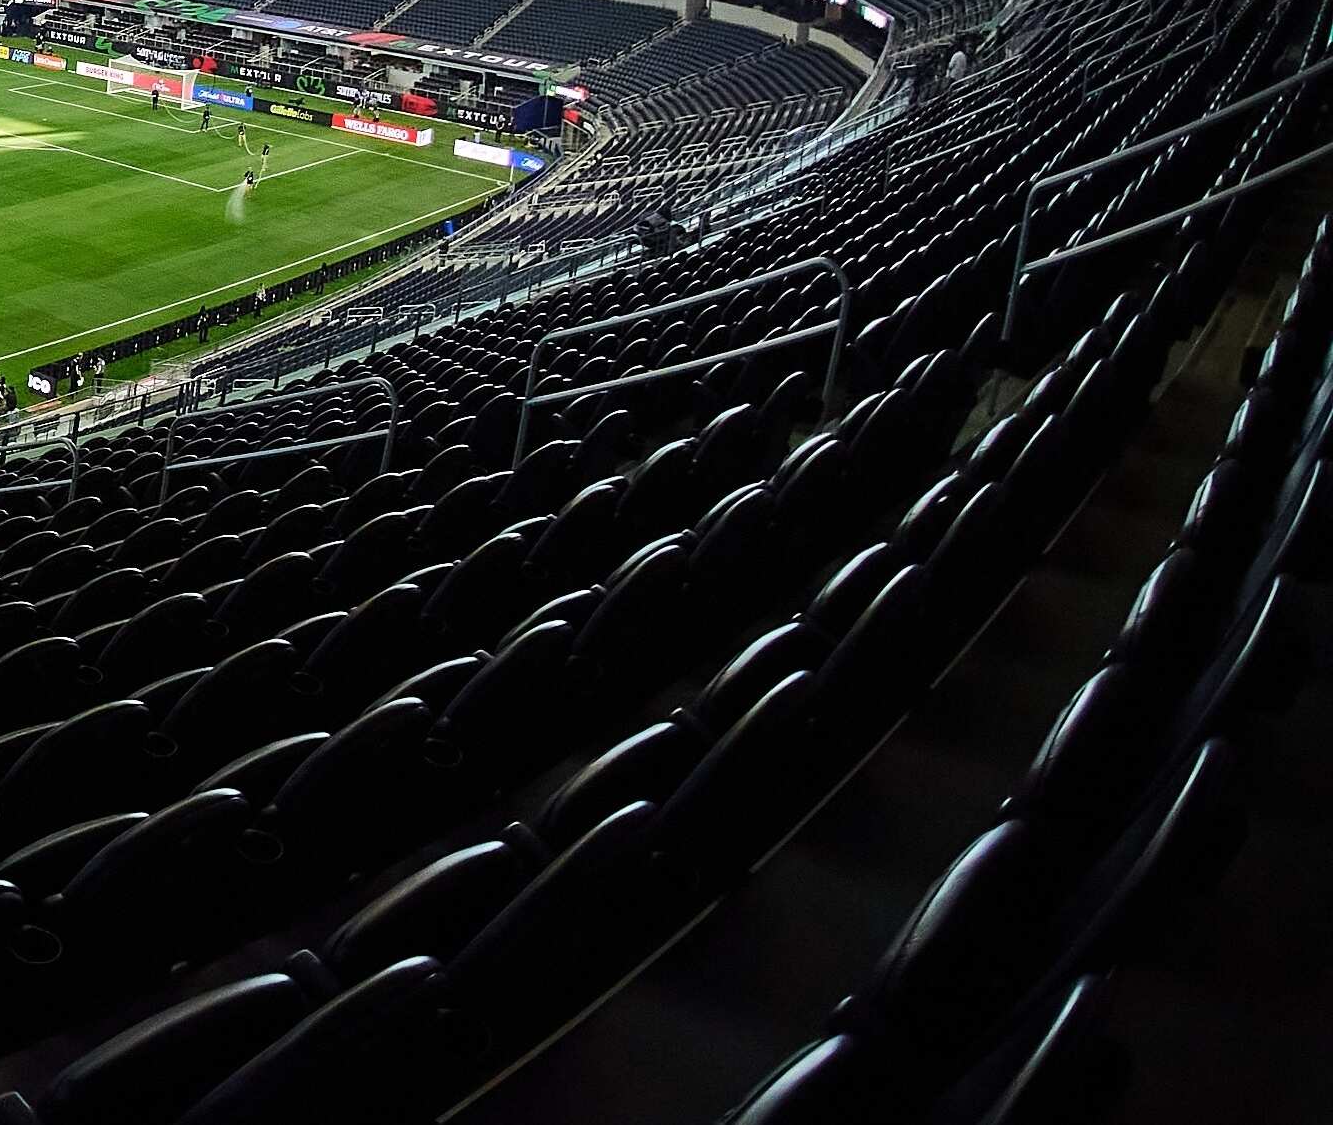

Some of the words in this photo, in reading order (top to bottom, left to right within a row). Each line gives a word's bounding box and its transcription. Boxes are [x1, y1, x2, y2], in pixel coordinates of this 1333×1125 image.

[298, 24, 353, 38] AT&T
[389, 40, 551, 72] MEXTOUR
[344, 118, 375, 134] WELLS
[376, 123, 410, 140] FARGO
